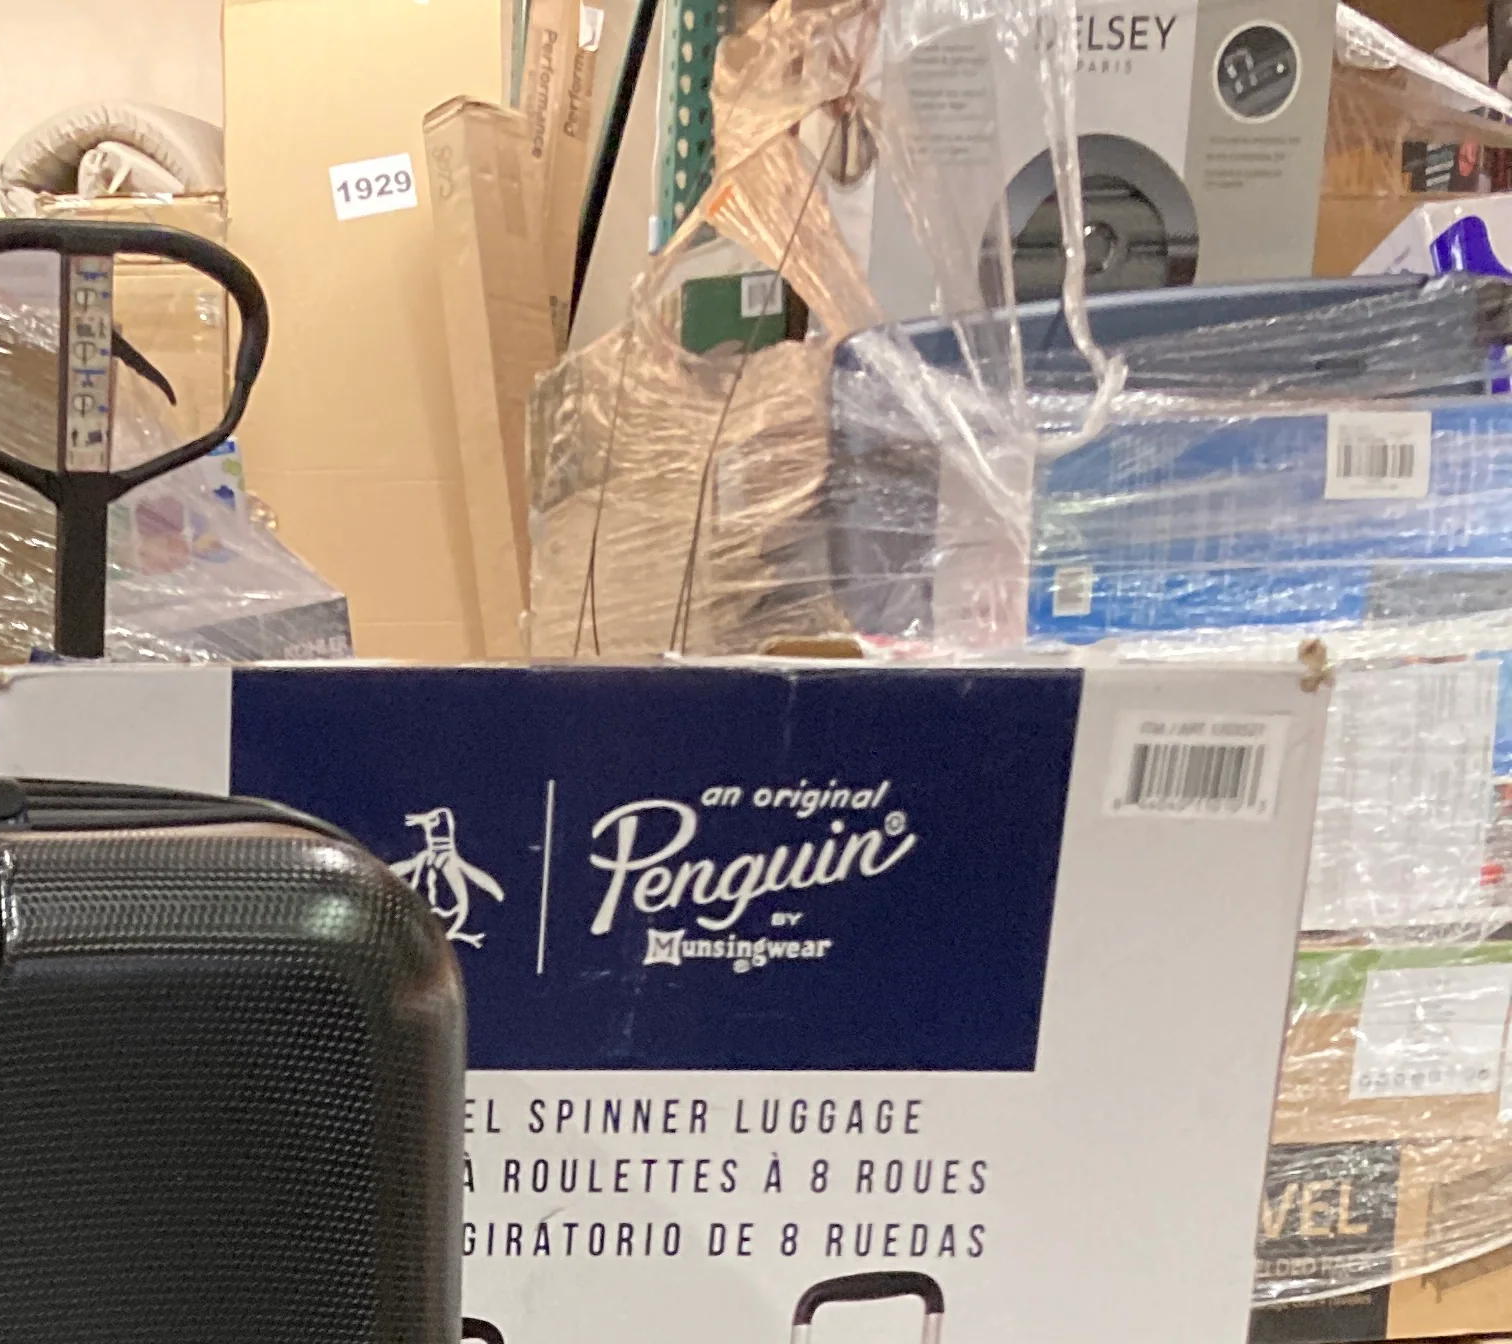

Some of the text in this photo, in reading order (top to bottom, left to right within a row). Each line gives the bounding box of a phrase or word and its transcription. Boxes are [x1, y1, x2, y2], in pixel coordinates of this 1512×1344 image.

[1076, 59, 1133, 75] PARIS
[531, 28, 559, 161] Performance
[563, 50, 586, 139] Perform
[336, 169, 413, 204] 1929
[700, 778, 891, 819] an original
[770, 911, 804, 927] BY
[641, 927, 833, 968] Munsingwear
[462, 1098, 924, 1135] EL SPINNER LUGGAGE
[502, 1158, 739, 1194] ROULETTES
[762, 1151, 783, 1194] À
[809, 1158, 831, 1194] 8
[855, 1158, 989, 1195] ROUES
[461, 1220, 987, 1259] GIRATORIO DE 8 RUEDAS
